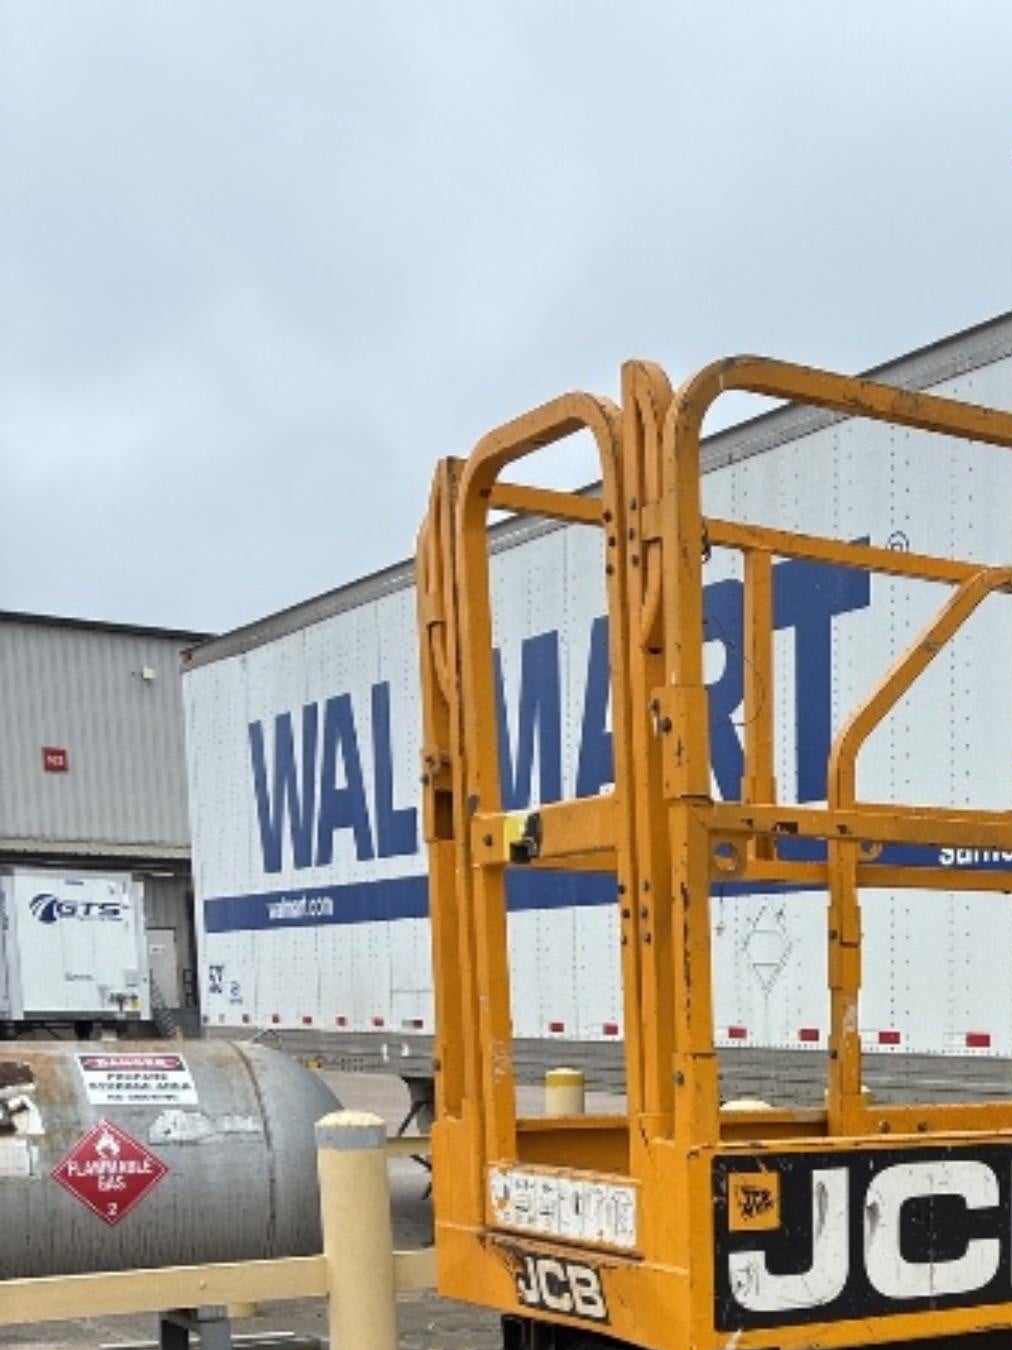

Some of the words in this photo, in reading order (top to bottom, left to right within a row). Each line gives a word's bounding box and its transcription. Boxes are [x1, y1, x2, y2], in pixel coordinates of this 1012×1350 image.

[55, 900, 121, 918] GTS
[97, 1175, 127, 1192] GAS
[107, 1201, 118, 1216] 2
[517, 1254, 610, 1319] JCB
